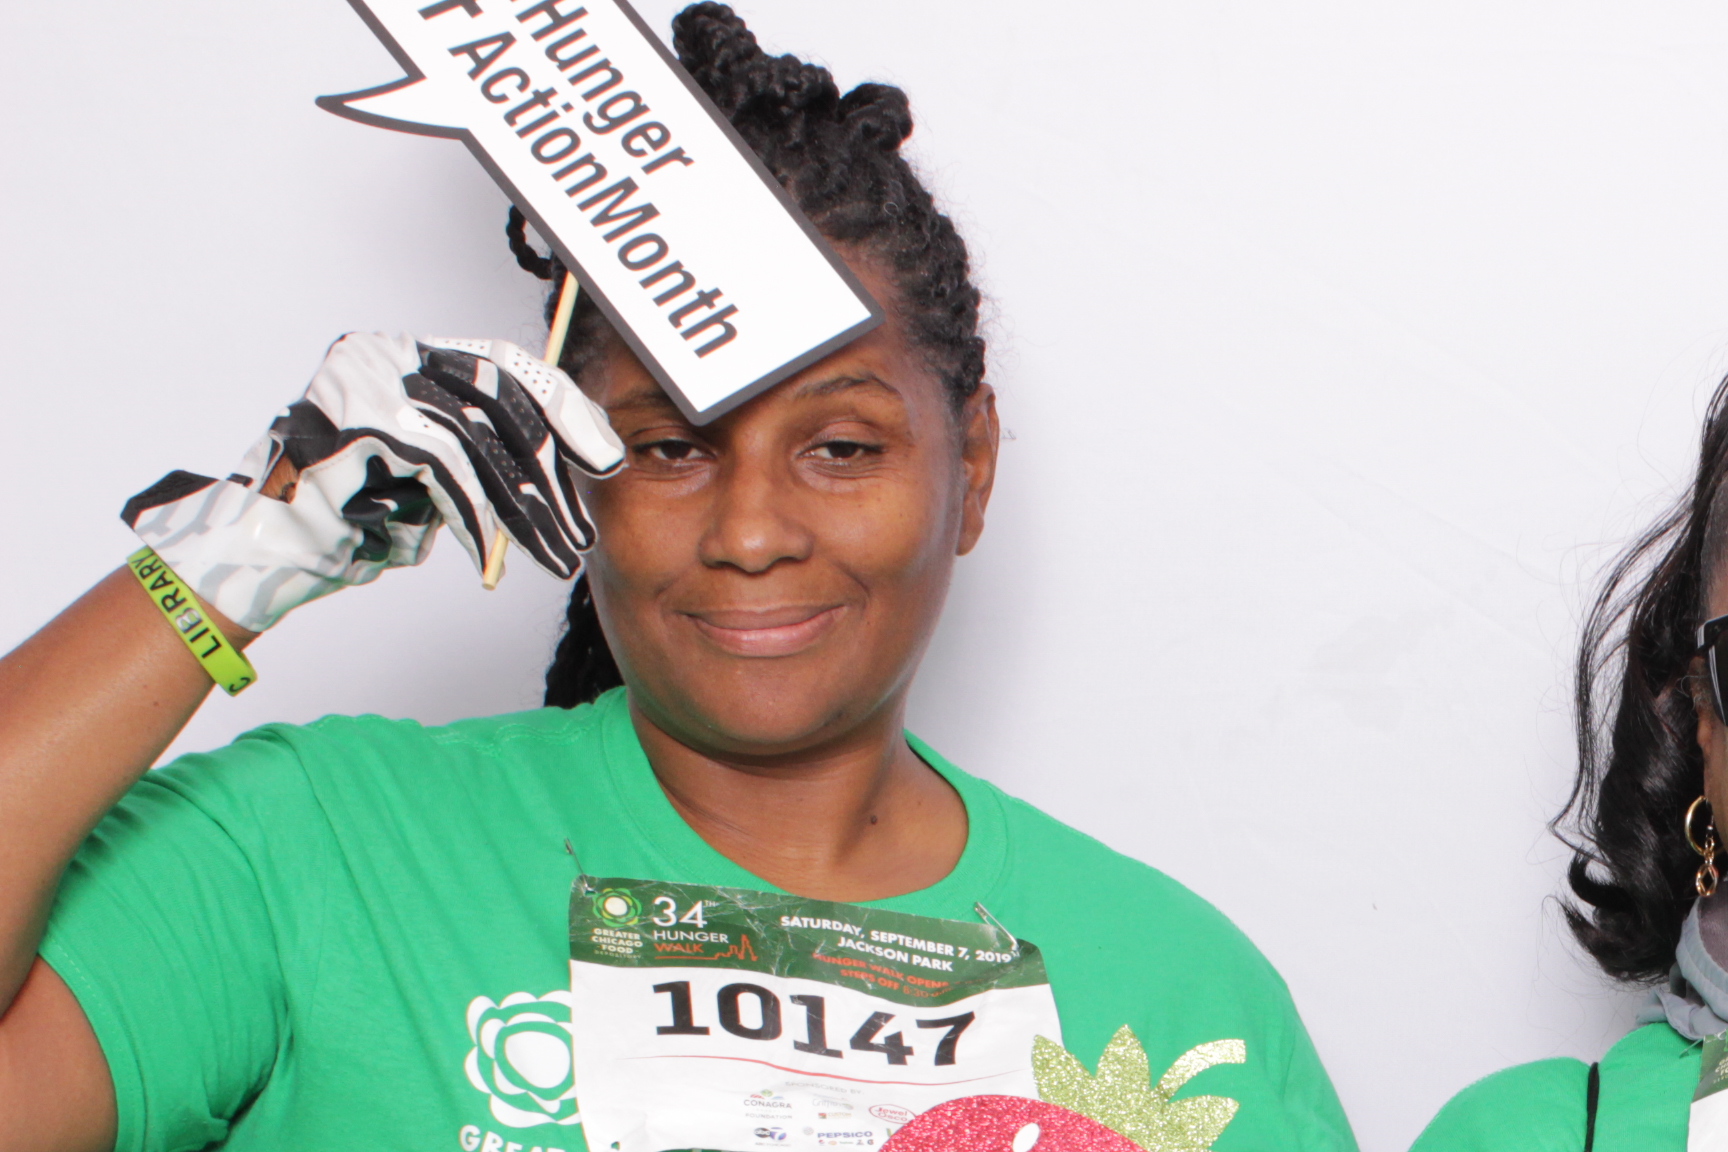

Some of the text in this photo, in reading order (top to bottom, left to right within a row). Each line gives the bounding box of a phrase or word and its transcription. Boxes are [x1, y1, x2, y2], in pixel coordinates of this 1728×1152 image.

[509, 0, 694, 175] Hunger
[447, 31, 739, 359] ActionMonth
[132, 552, 222, 659] LIBRARY
[592, 928, 641, 940] GREATER
[652, 930, 729, 943] HUNGER
[780, 916, 1012, 963] SATURDAY, SEPTEMBER 7, 2019
[591, 935, 643, 948] CHICAGO
[653, 943, 704, 953] WALK
[837, 936, 953, 972] JACKSON PARK
[812, 952, 867, 968] HUNGER
[870, 962, 904, 979] WALK
[840, 969, 876, 983] STEPS
[878, 977, 900, 990] OFF
[651, 981, 975, 1067] 10147
[785, 1081, 847, 1094] SPONSORED
[744, 1099, 792, 1109] CONAGRA
[745, 1112, 792, 1120] FOUNDATION
[875, 1107, 908, 1116] Jewel
[817, 1131, 873, 1139] PEPSICO
